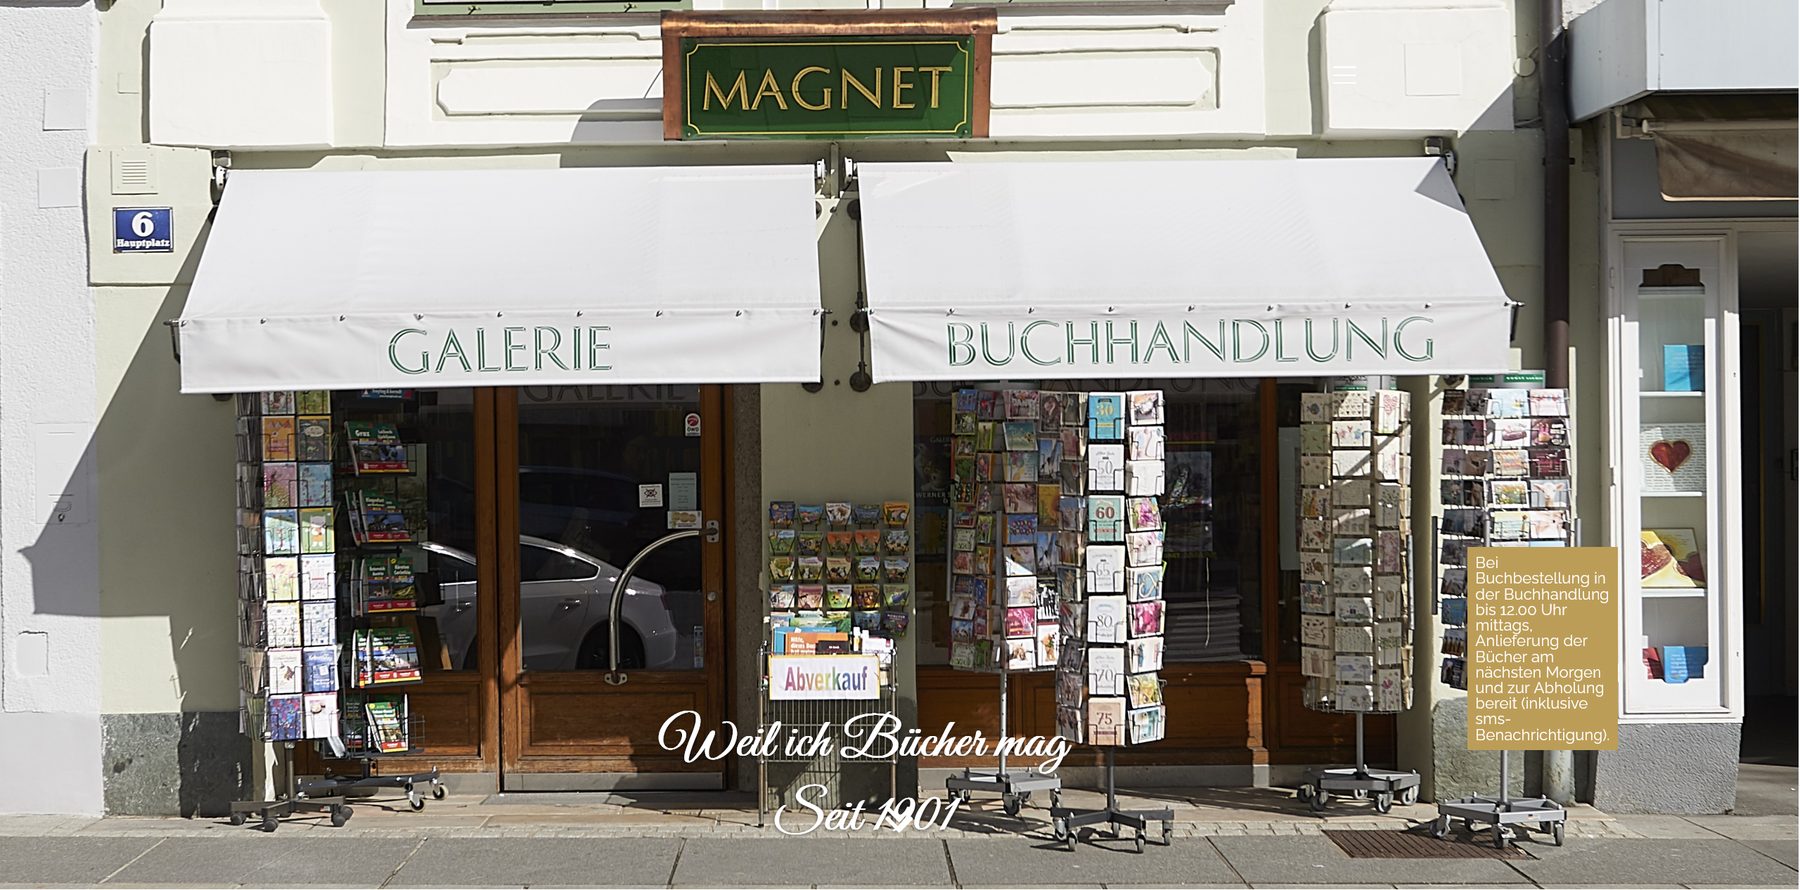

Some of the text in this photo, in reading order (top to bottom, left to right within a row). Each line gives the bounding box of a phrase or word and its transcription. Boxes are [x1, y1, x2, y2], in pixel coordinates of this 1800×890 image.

[702, 66, 954, 111] MAGNET
[131, 211, 155, 238] 6
[116, 238, 171, 249] Hauptplatz
[387, 326, 613, 374] GALERIE
[944, 318, 1436, 368] BUCHHANDLUNG
[1097, 460, 1113, 475] 50
[1095, 506, 1115, 520] 60
[1096, 562, 1111, 577] 65
[1097, 614, 1113, 628] 80
[784, 665, 868, 691] Abverkauf
[1096, 668, 1114, 682] 70
[1096, 711, 1113, 726] 75
